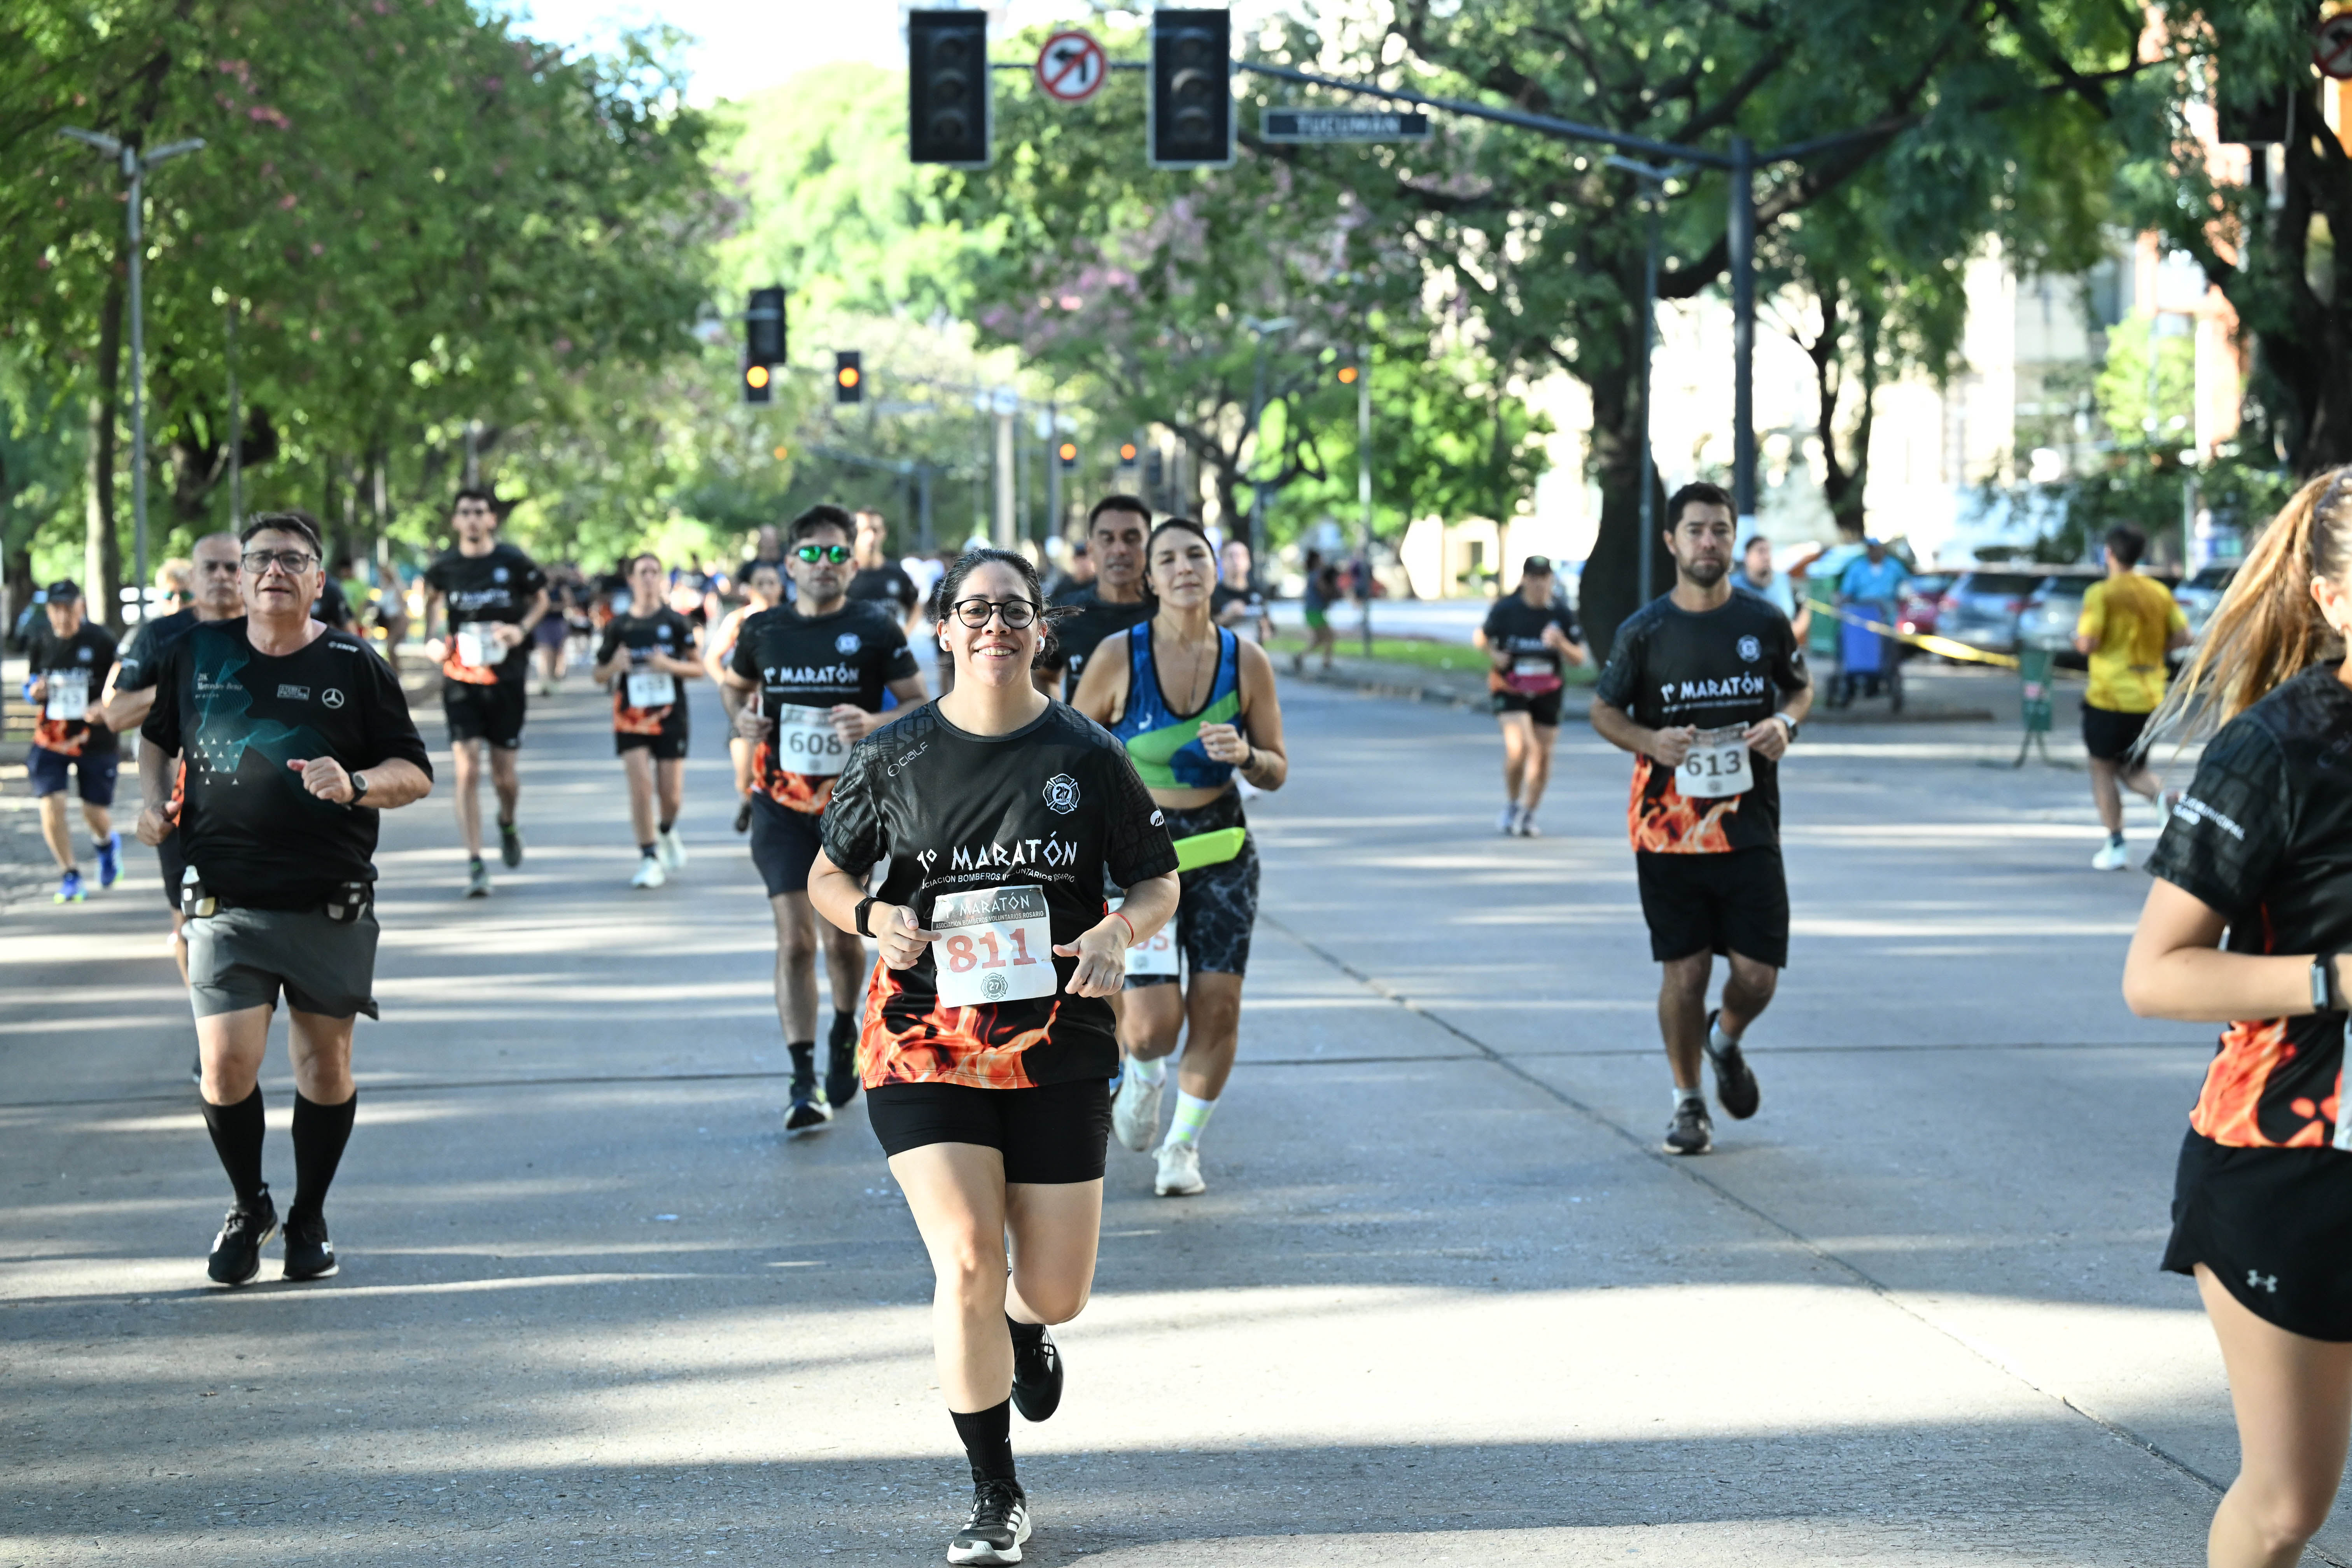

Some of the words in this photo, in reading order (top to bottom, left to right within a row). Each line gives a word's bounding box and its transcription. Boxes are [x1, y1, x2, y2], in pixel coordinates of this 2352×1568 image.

[780, 662, 860, 684] MARATÓN
[1680, 670, 1764, 700] MARATÓN
[790, 732, 843, 755] 608
[1686, 750, 1741, 777] 613
[1056, 786, 1070, 800] 27
[951, 831, 1077, 871] MARATÓN
[922, 875, 956, 889] CIACIÓN
[958, 873, 1001, 882] BOMBEROS
[960, 892, 1030, 916] MARATÓN
[936, 920, 962, 929] ASOCIACIÓN
[962, 917, 988, 926] BOMBEROS
[989, 913, 1022, 922] VOLUNTARIOS
[947, 928, 1036, 973] 811
[989, 981, 999, 991] 27
